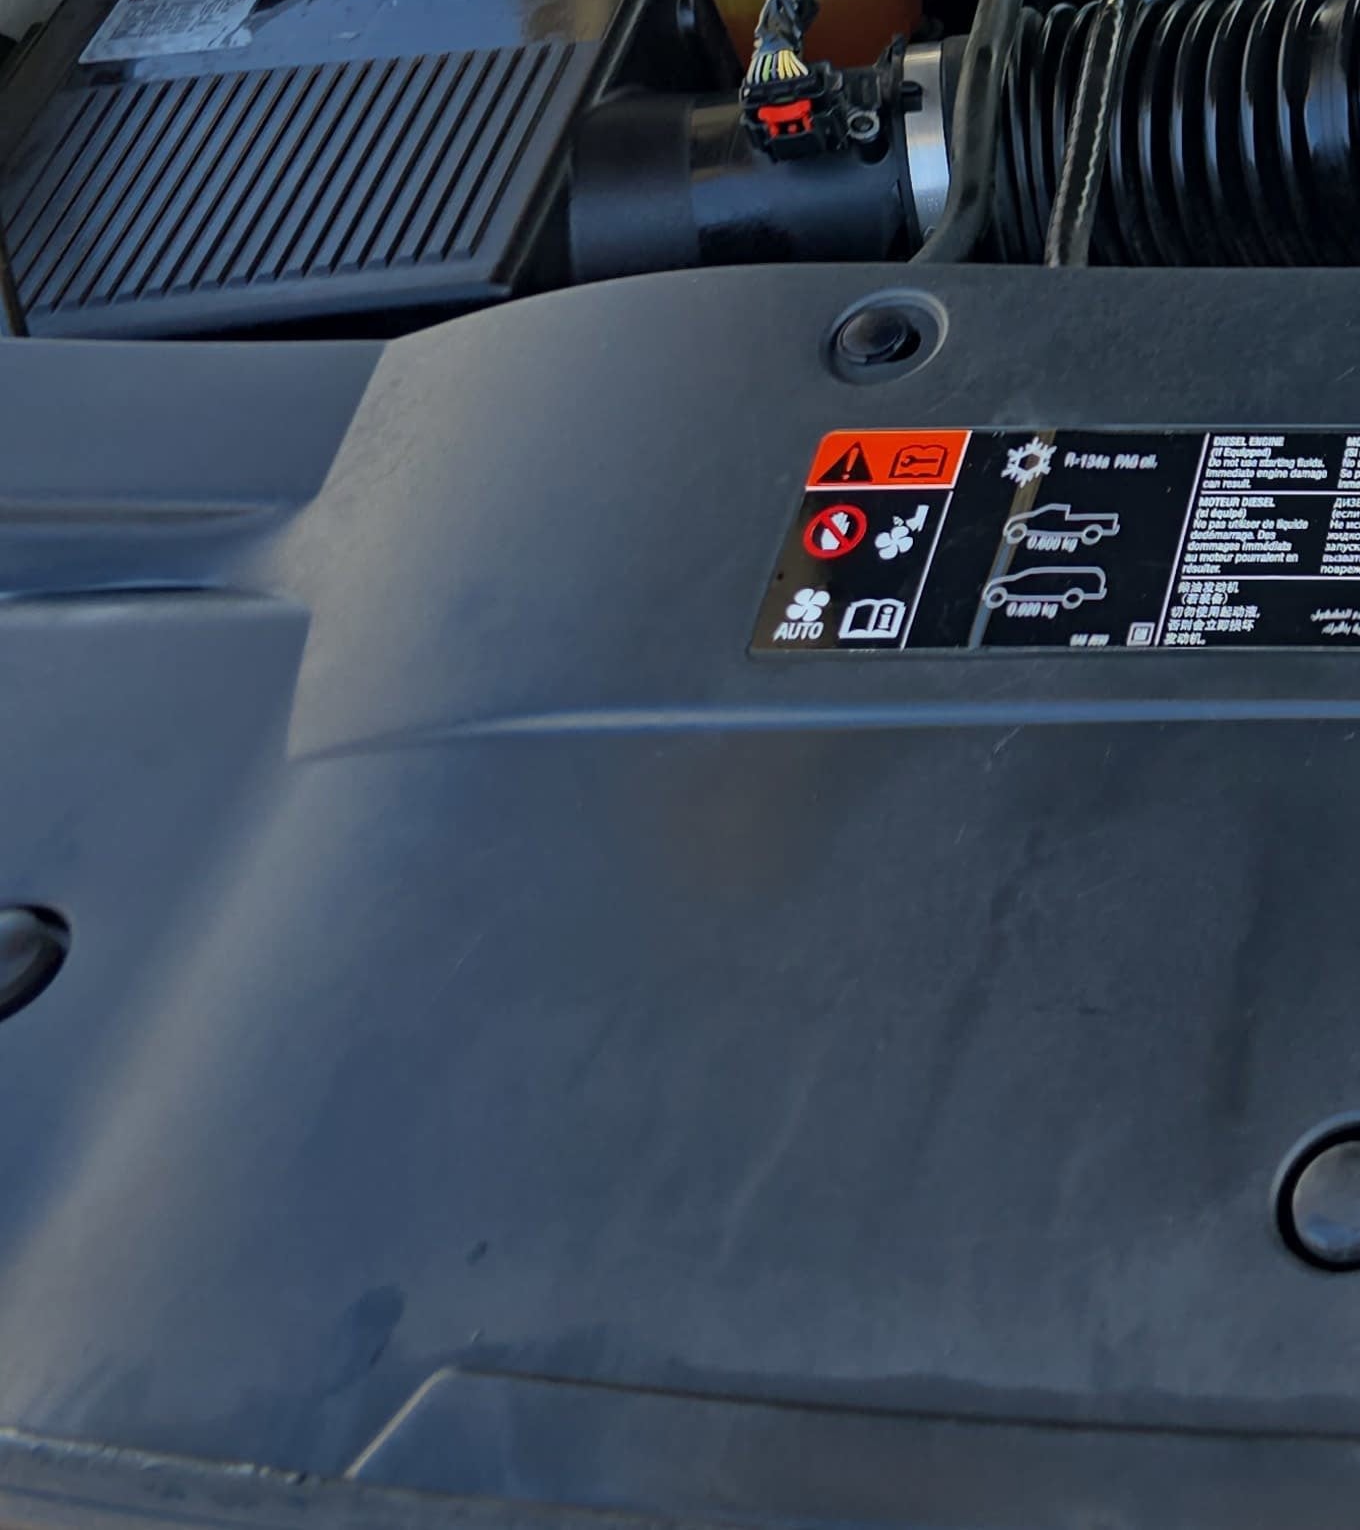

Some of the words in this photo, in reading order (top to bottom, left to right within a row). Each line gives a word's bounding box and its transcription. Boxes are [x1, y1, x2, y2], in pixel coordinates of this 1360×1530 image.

[1213, 436, 1247, 446] DIESEL
[1248, 436, 1285, 446] ENGINE
[1223, 458, 1239, 467] not
[1240, 459, 1257, 467] use
[1259, 457, 1295, 469] starting
[1342, 458, 1355, 468] No
[1256, 468, 1288, 479] engine
[1289, 468, 1328, 480] damage
[1202, 479, 1221, 488] can
[1198, 496, 1240, 507] MOTEUR
[1241, 496, 1276, 507] DIESEL
[1331, 509, 1360, 519] (если
[1193, 519, 1207, 529] Ne
[1208, 520, 1226, 530] pas
[1228, 519, 1260, 529] utiliser
[1262, 519, 1275, 529] de
[1329, 520, 1343, 530] Не
[1257, 530, 1276, 540] Des
[1061, 537, 1079, 553] kg
[1187, 541, 1240, 552] dommages
[1184, 553, 1198, 563] au
[1199, 552, 1234, 563] moteur
[1234, 552, 1285, 564] pourraient
[1285, 553, 1299, 563] en
[1041, 602, 1059, 619] kg
[773, 621, 824, 642] AUTO
